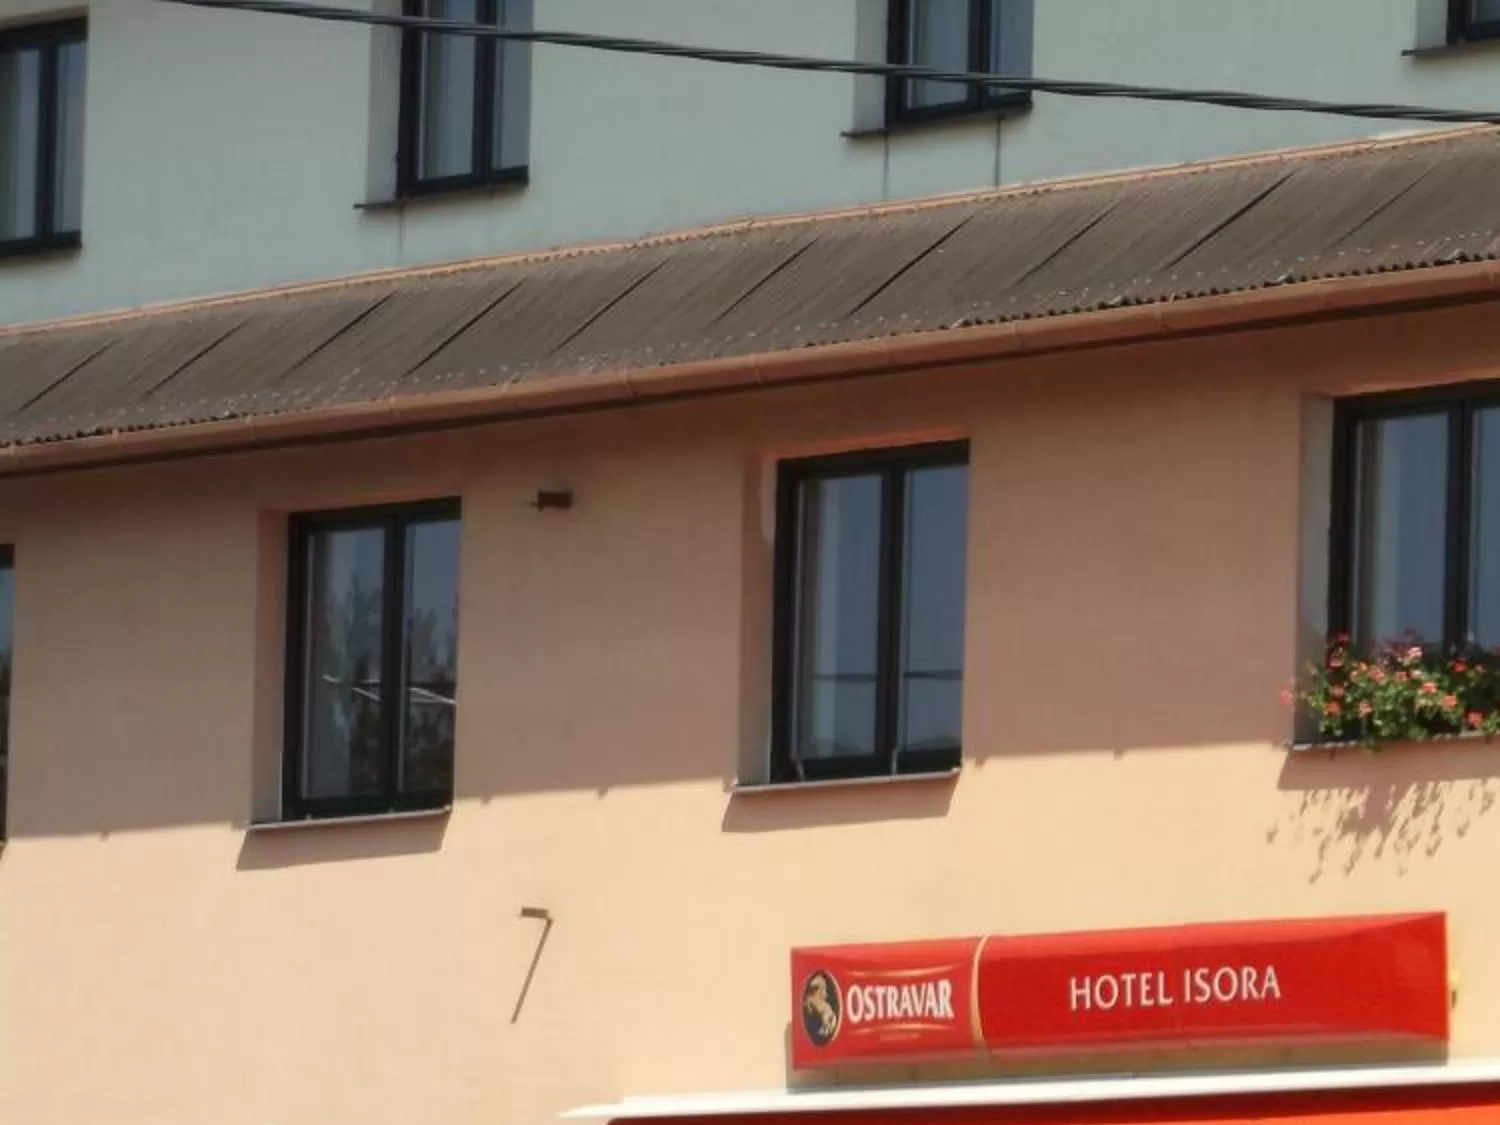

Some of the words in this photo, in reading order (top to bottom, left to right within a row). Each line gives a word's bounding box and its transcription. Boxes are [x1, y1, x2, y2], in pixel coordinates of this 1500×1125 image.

[846, 979, 955, 1023] OSTRAVAR
[1070, 971, 1173, 1012] HOTEL
[1184, 965, 1281, 1004] ISORA
